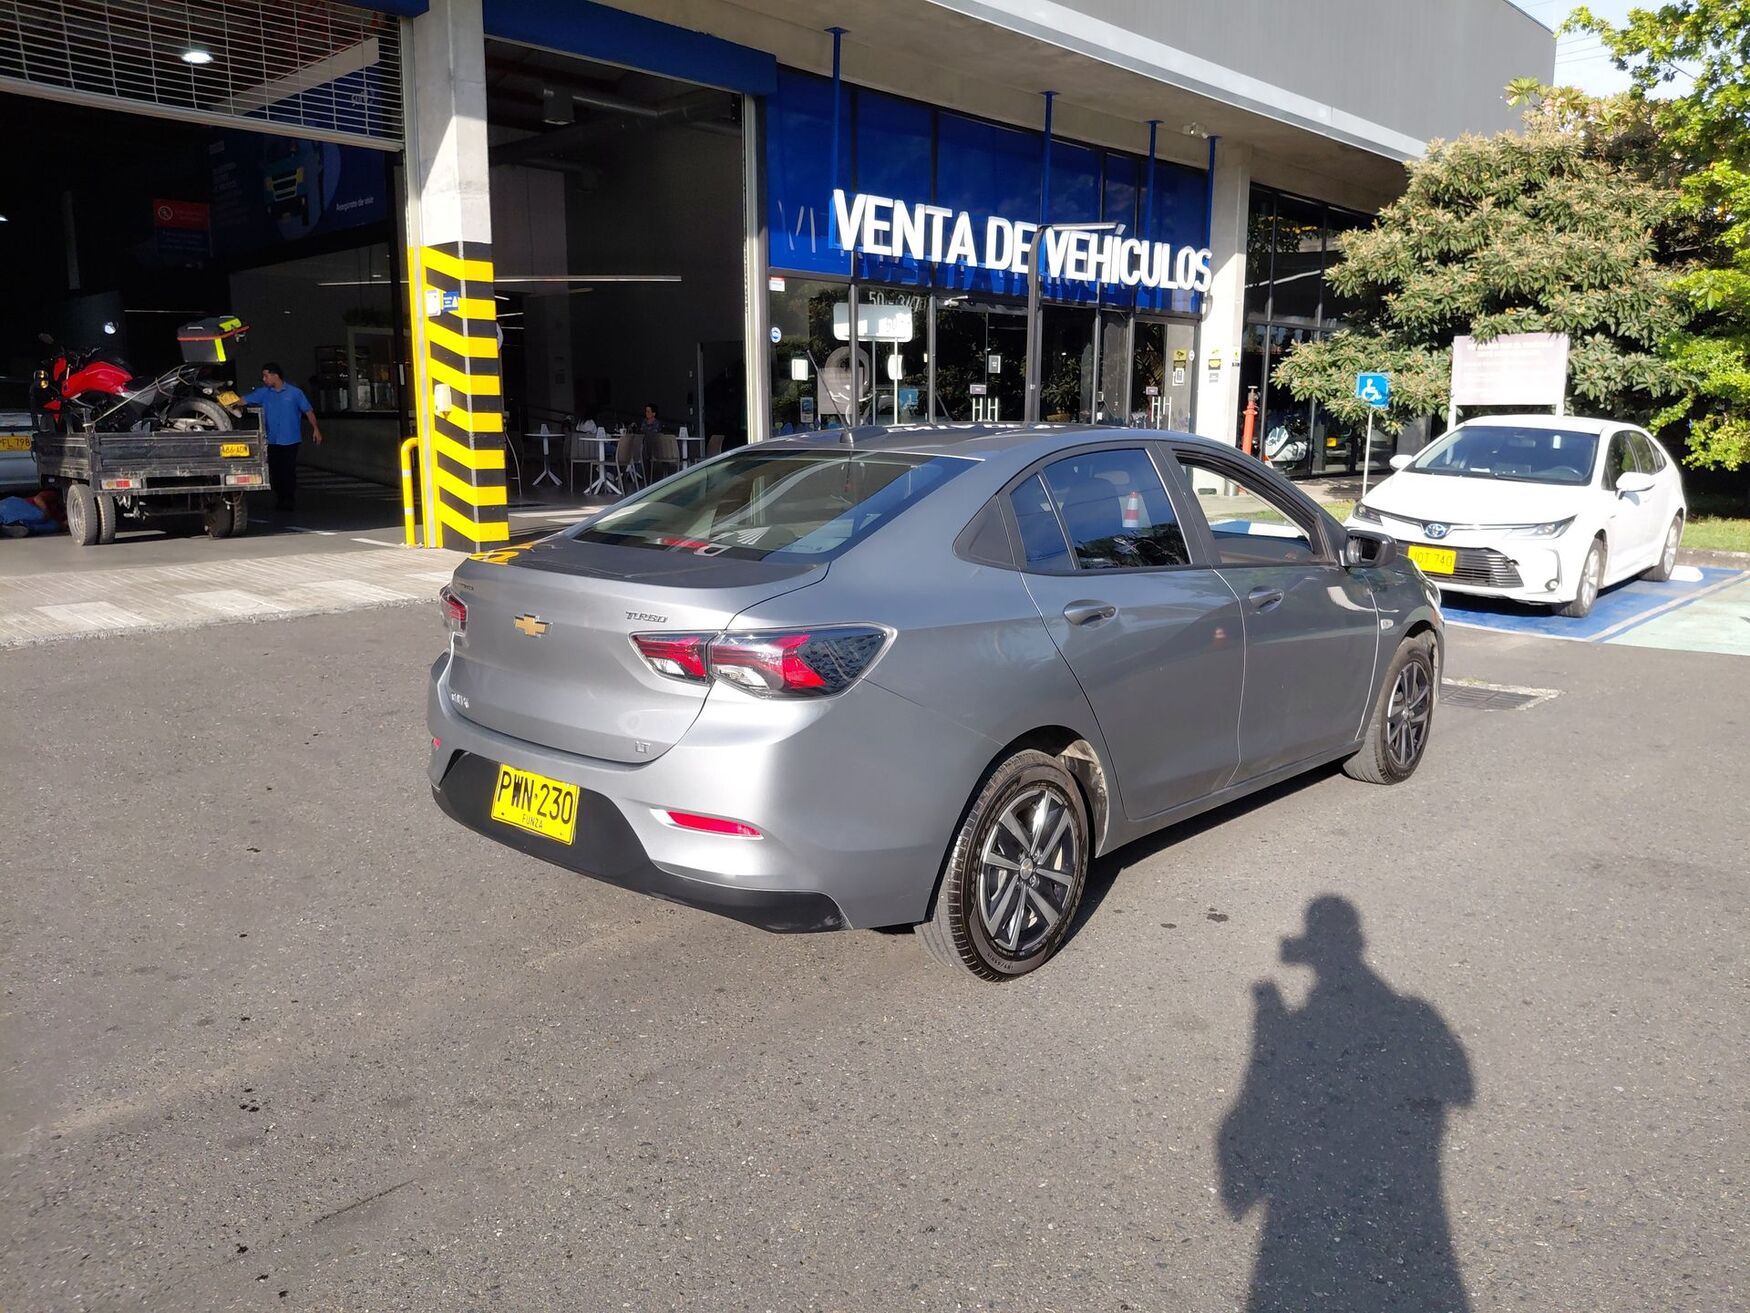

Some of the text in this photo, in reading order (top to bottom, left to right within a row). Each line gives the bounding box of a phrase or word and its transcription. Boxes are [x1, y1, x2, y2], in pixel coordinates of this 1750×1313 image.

[833, 188, 1213, 293] VENTA DE VEHÍCULOS
[14, 438, 31, 448] 798
[1434, 553, 1453, 567] 740
[625, 610, 668, 623] TURBO
[522, 813, 544, 830] FUNZA
